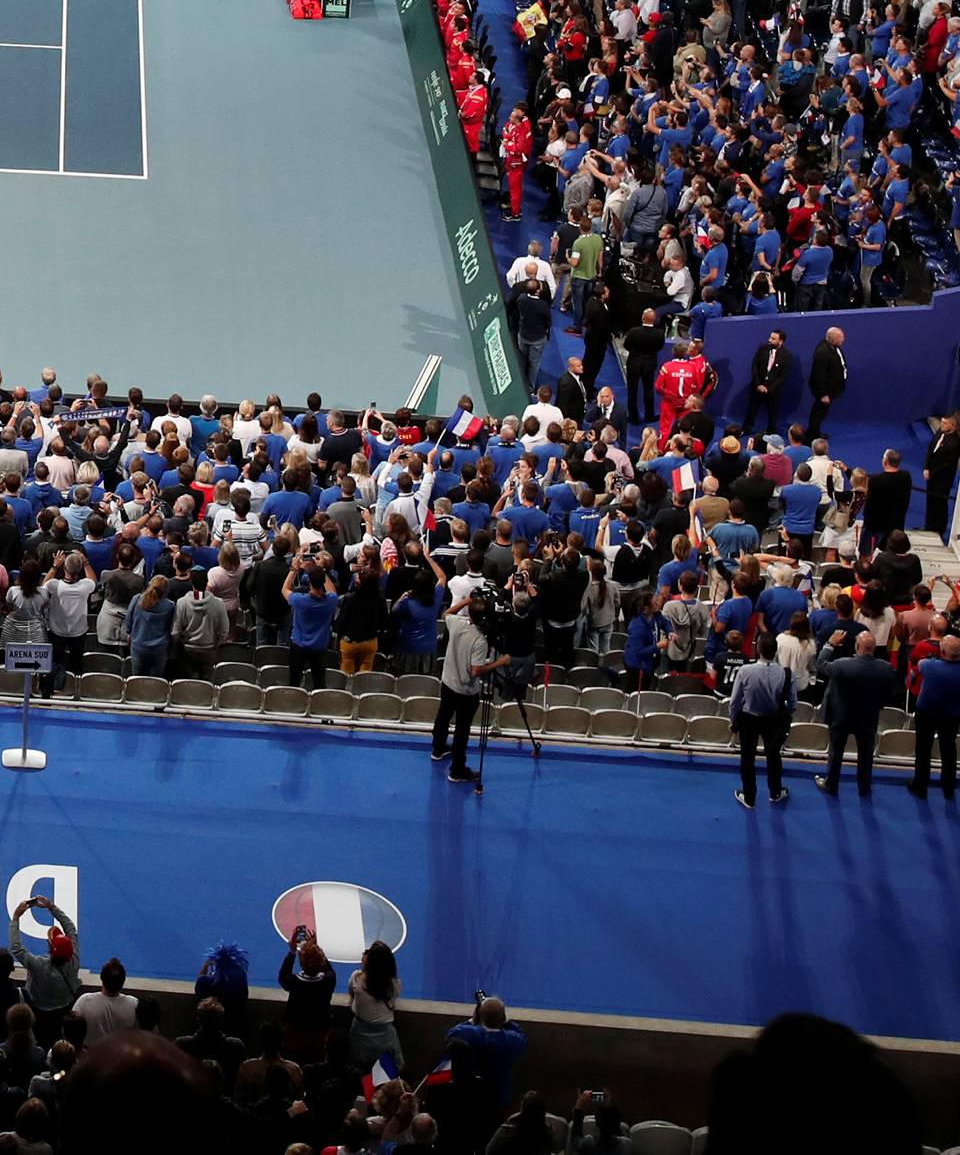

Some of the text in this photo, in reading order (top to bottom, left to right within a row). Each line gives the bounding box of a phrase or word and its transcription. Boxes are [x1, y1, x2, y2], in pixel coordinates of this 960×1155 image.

[454, 218, 480, 285] Adecco
[9, 650, 49, 659] ARENA SUD
